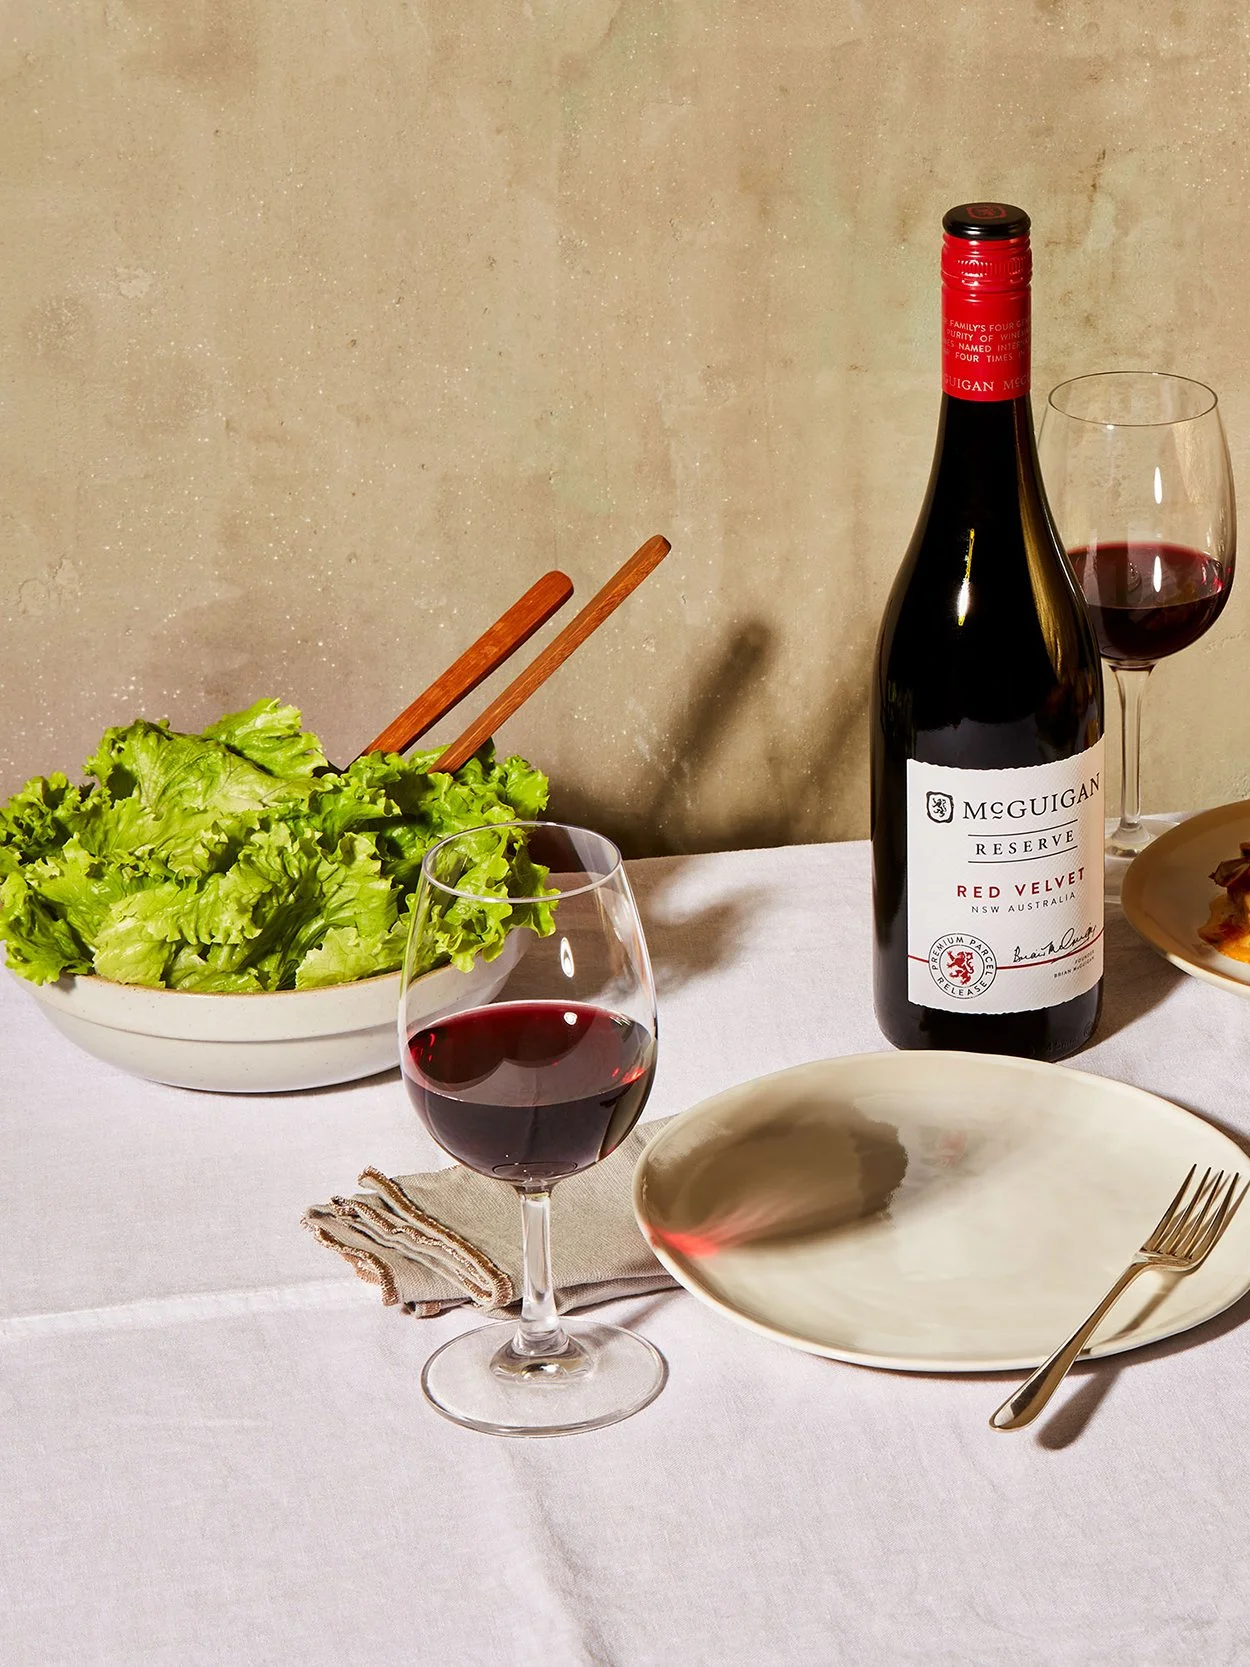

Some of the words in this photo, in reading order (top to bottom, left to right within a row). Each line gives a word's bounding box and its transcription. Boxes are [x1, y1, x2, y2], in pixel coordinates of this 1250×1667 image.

[949, 319, 986, 332] FAMILY'S
[989, 322, 1014, 332] FOUR
[955, 352, 979, 362] FOUR
[986, 353, 1013, 362] TIMES
[958, 342, 992, 353] NAMED
[975, 829, 1074, 855] RESERVE
[957, 885, 1001, 898] RED
[1014, 867, 1085, 896] VELVET
[971, 905, 1000, 914] NSW
[1007, 891, 1076, 913] AUSTRALIA
[931, 936, 964, 970] PREMIUM
[969, 938, 994, 976] PARCEL
[936, 977, 988, 997] RELEASE
